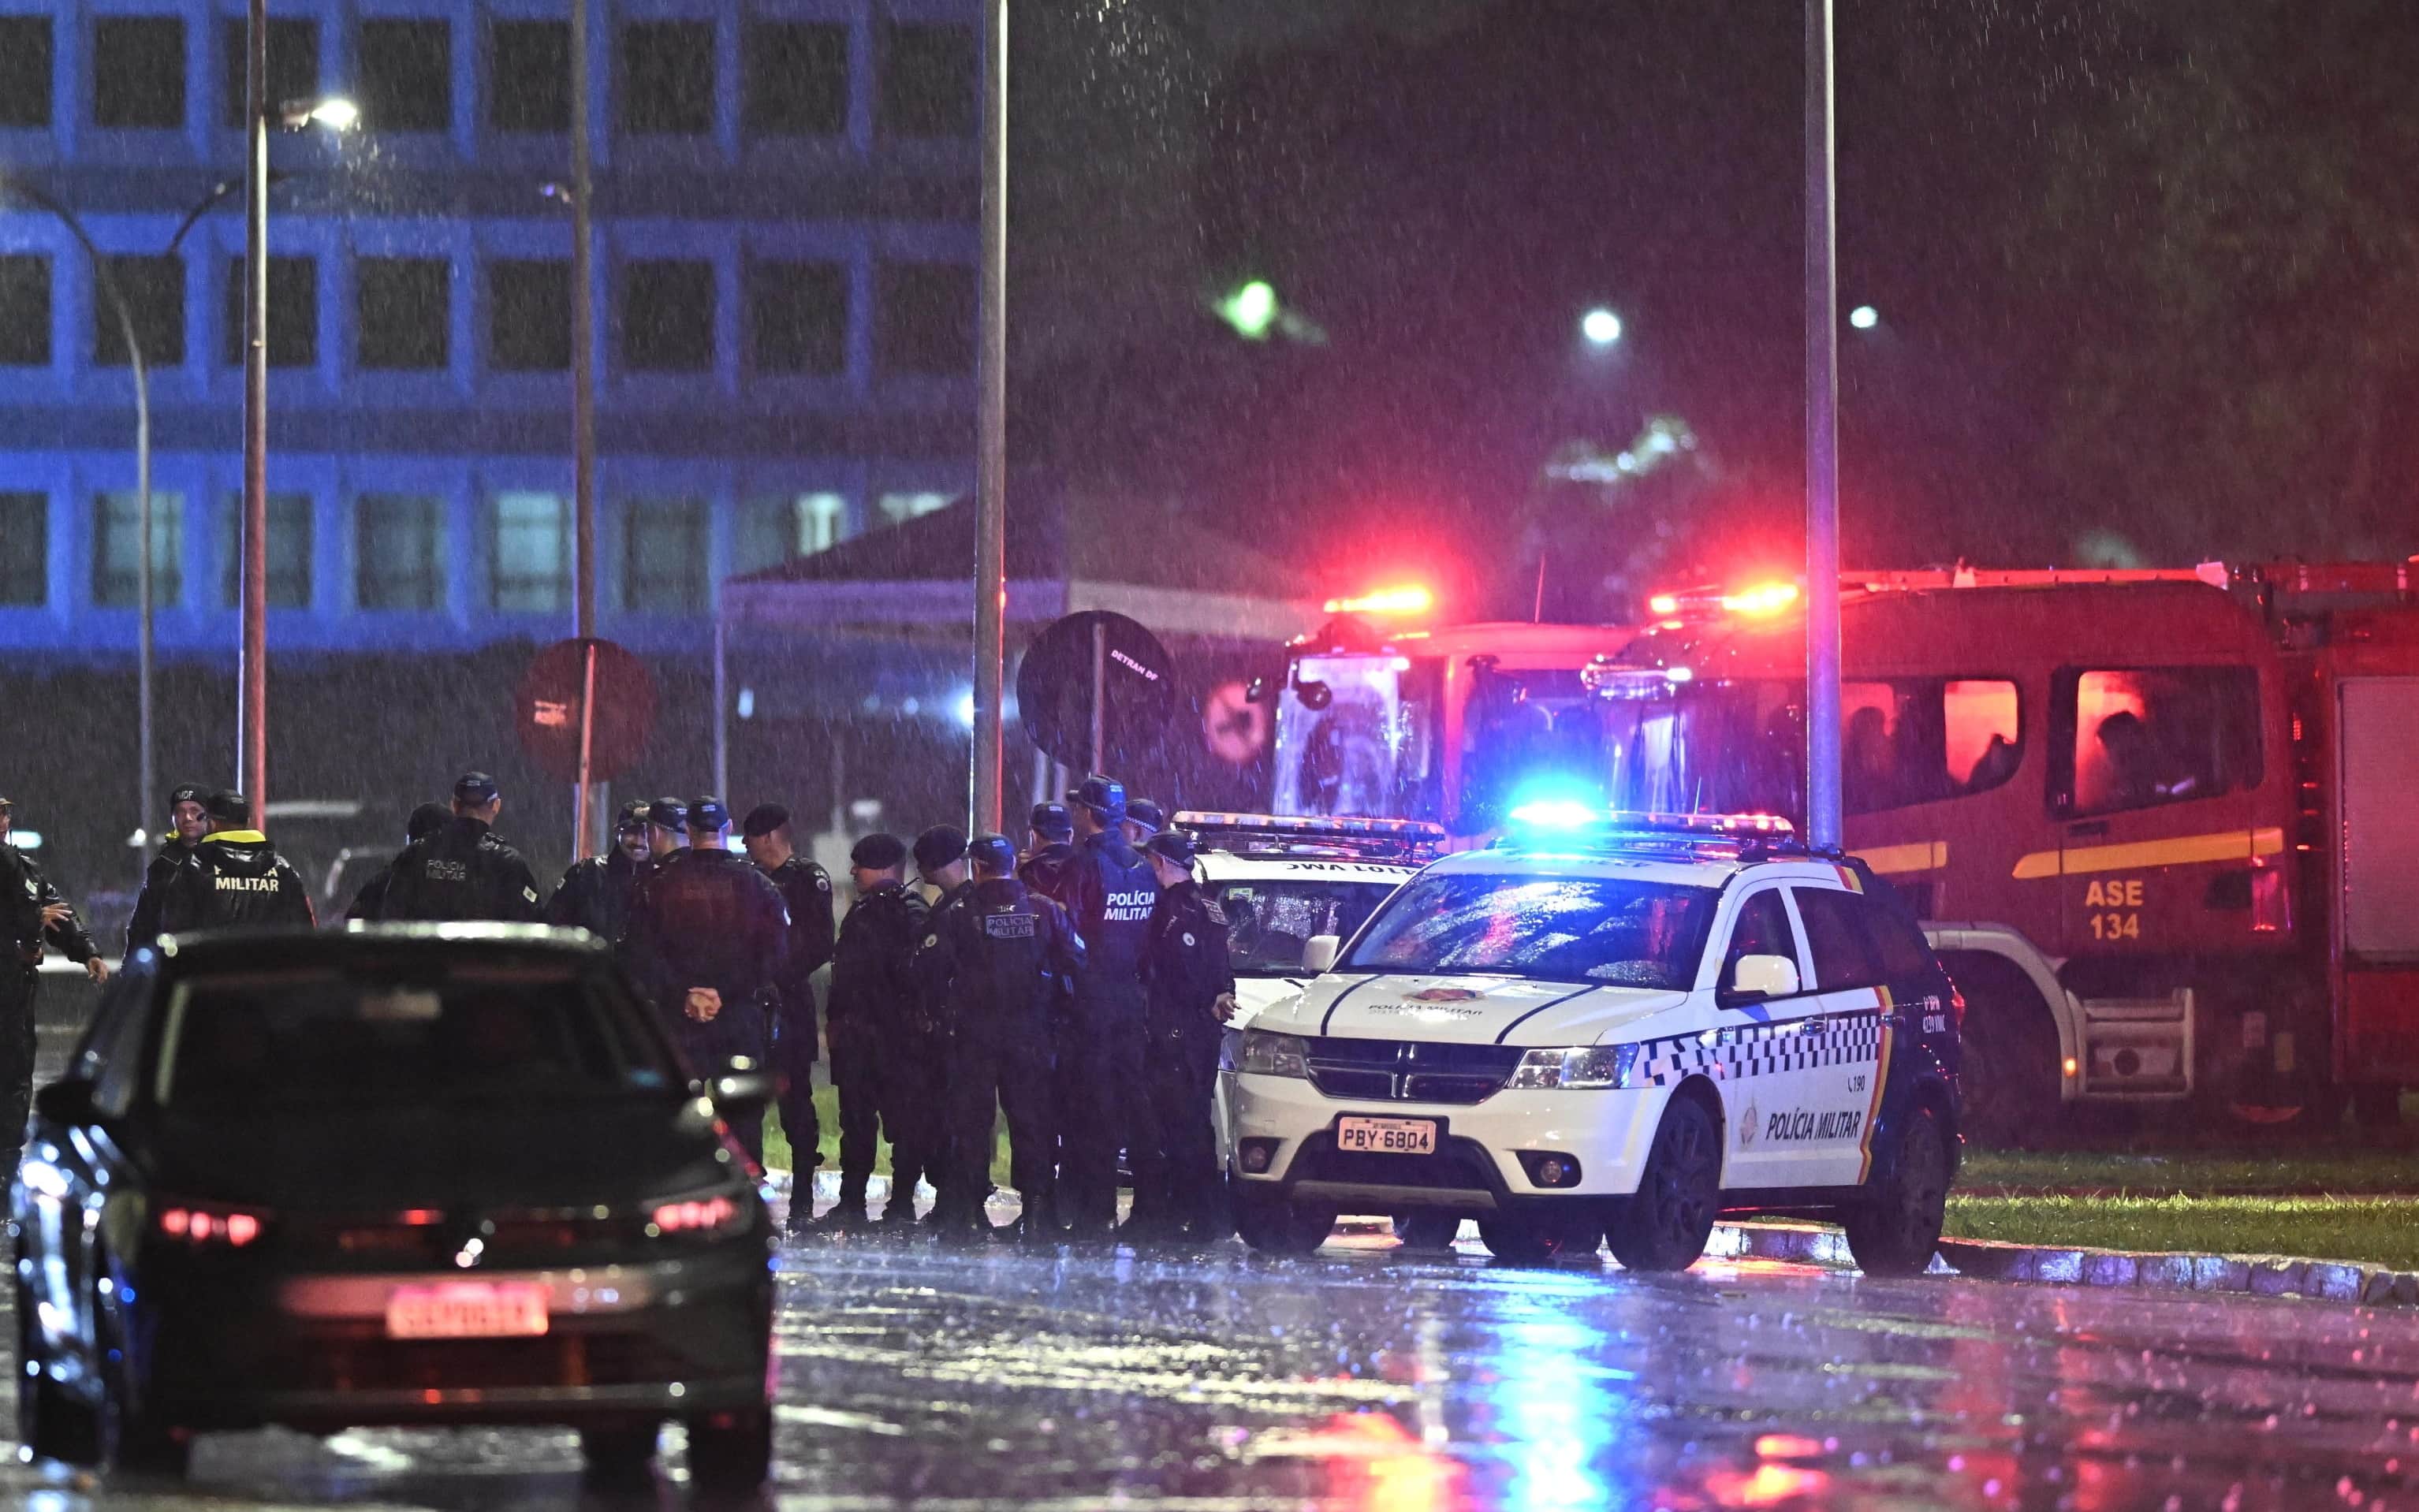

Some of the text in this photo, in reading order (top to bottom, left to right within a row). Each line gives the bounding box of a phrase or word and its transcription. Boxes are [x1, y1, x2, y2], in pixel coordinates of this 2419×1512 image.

[1111, 650, 1146, 675] DETRAN
[215, 877, 279, 892] MILITAR
[2085, 880, 2144, 907] ASE
[1106, 889, 1155, 907] POLÍCIA
[2090, 913, 2139, 940] 134
[1853, 1074, 1866, 1092] 190
[1765, 1107, 1862, 1141] POLÍCIA MILITAR
